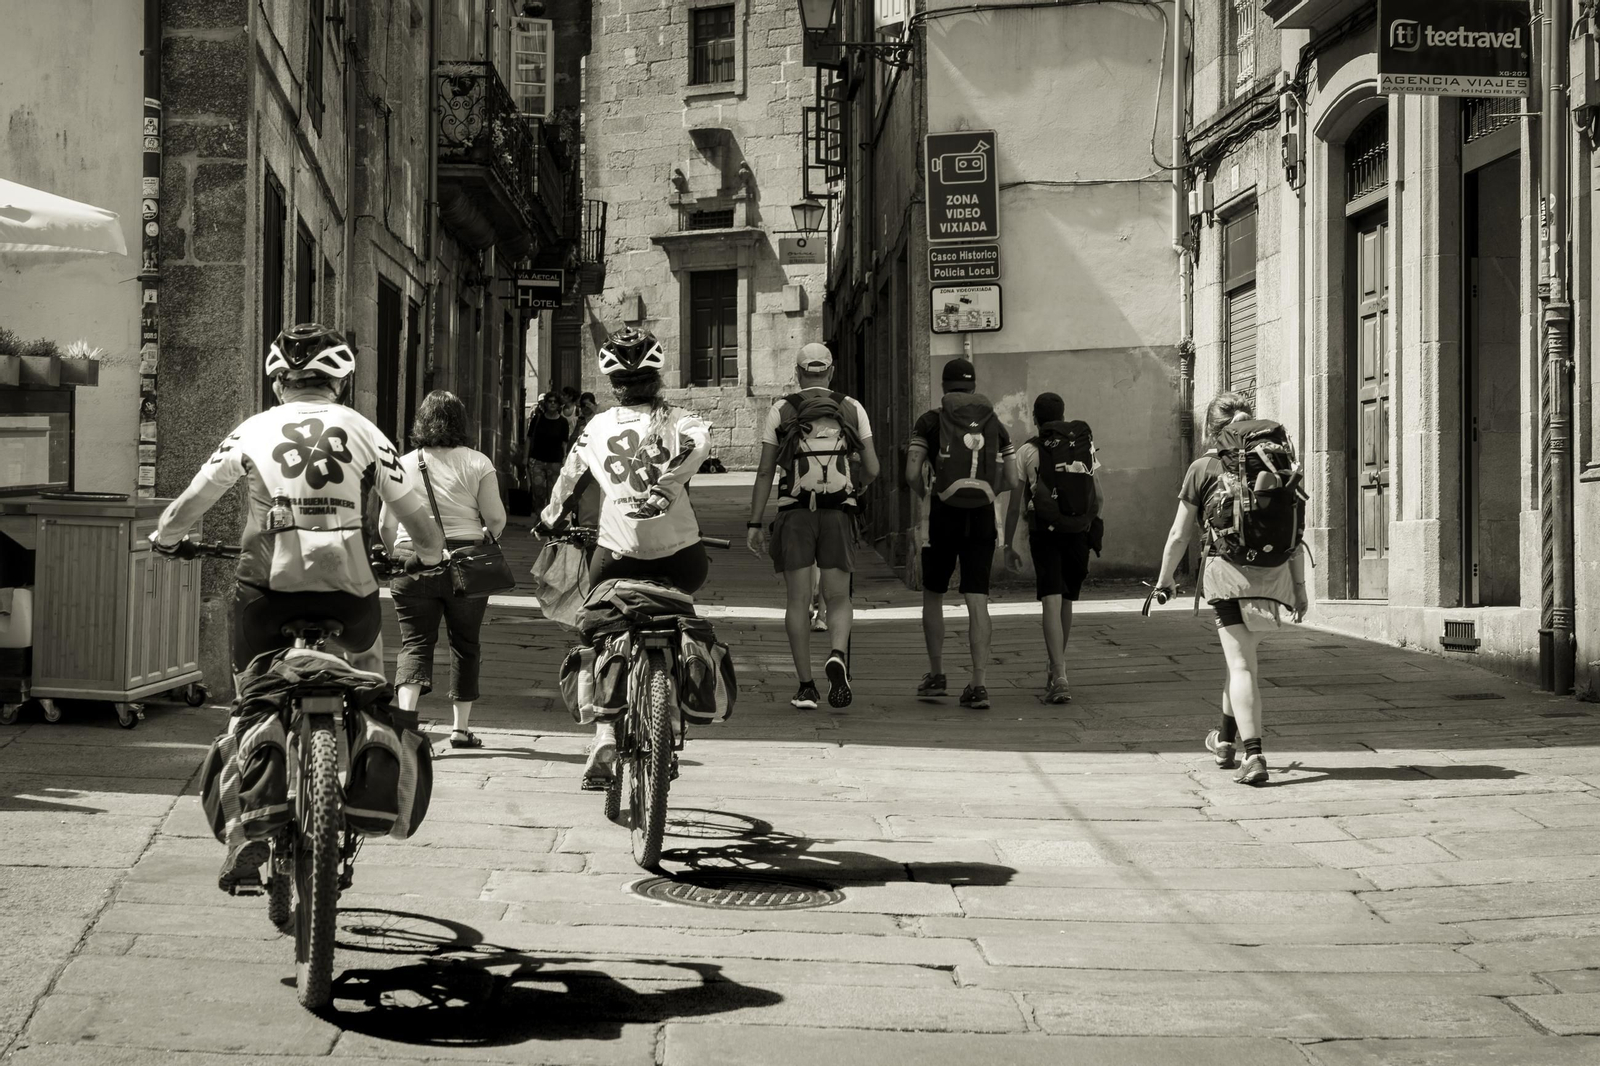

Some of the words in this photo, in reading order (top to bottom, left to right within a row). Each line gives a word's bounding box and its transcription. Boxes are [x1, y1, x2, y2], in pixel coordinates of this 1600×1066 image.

[1425, 25, 1522, 48] teetravel
[1382, 76, 1460, 86] AGENCIA
[1467, 78, 1527, 88] VIAJES
[946, 194, 979, 205] ZONA
[946, 207, 981, 219] VIDEO
[940, 221, 987, 233] VIXIADA
[931, 251, 957, 261] Casco
[959, 250, 997, 260] Historico
[934, 267, 965, 277] Policia
[968, 265, 994, 276] Local
[518, 288, 559, 308] HOTEL
[295, 424, 312, 439] Y
[328, 437, 344, 452] B
[616, 436, 630, 450] Y
[283, 448, 302, 468] B
[313, 458, 329, 476] T
[610, 460, 625, 475] B
[635, 467, 649, 481] T
[303, 497, 329, 506] BUENA
[330, 498, 355, 510] BIKERS
